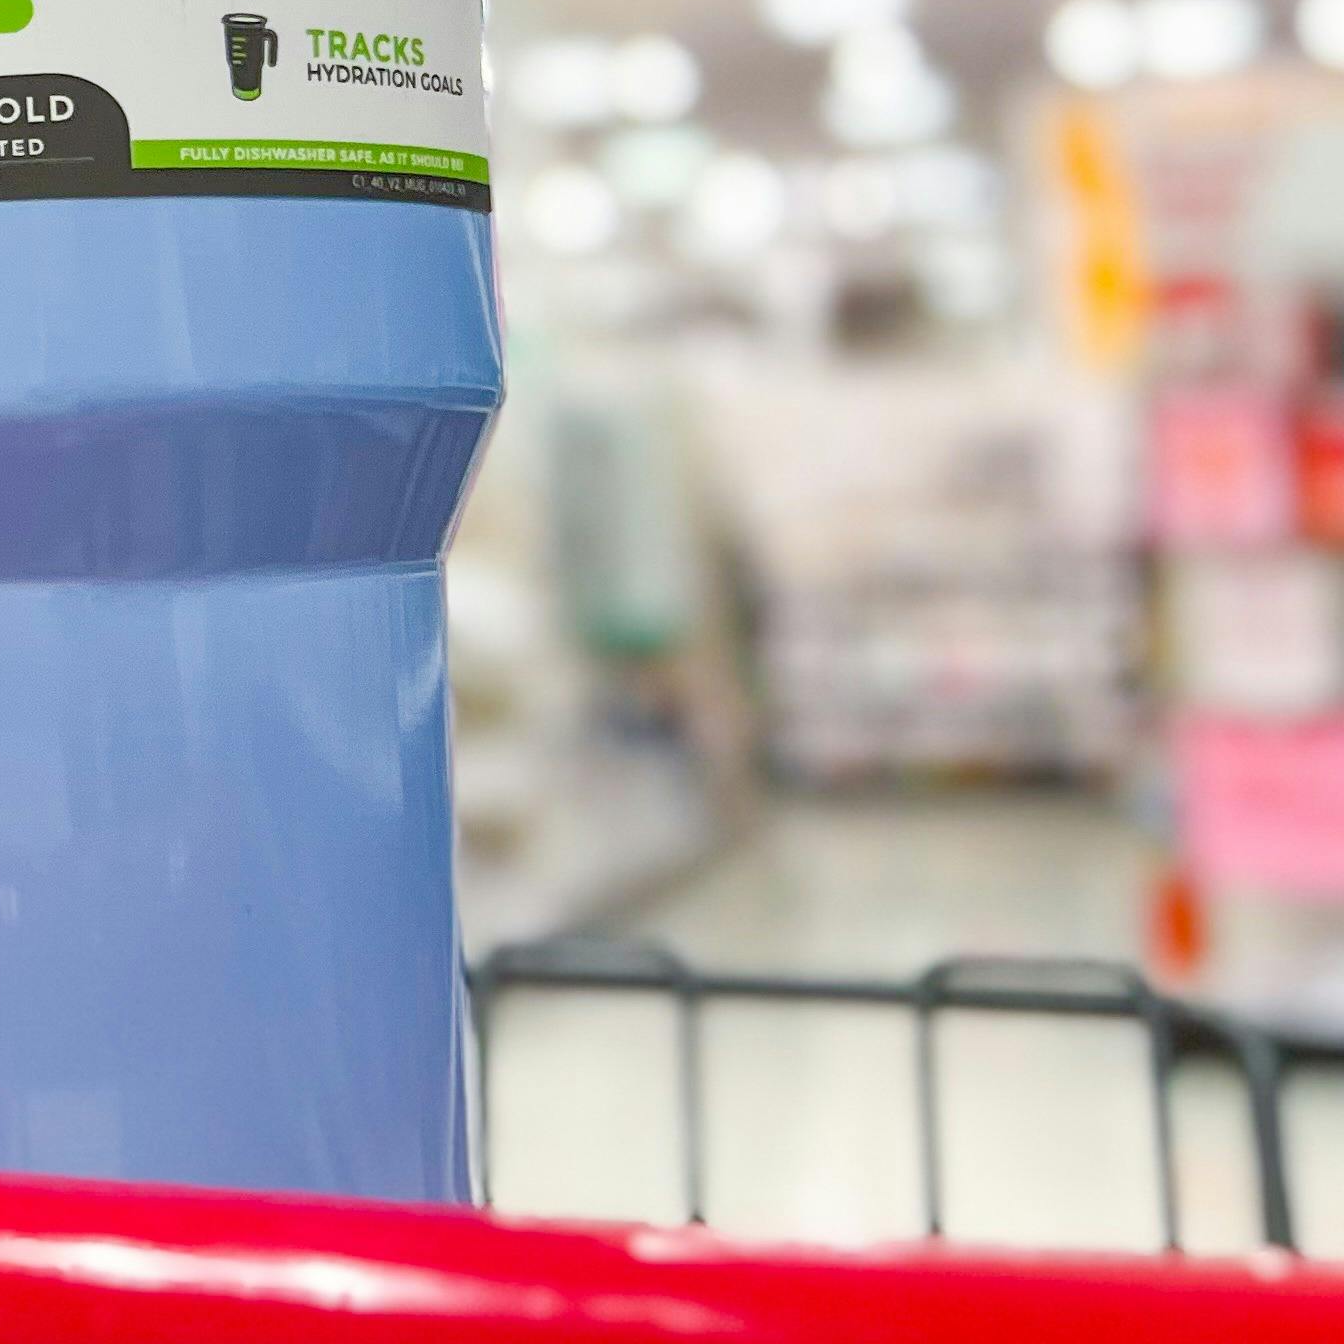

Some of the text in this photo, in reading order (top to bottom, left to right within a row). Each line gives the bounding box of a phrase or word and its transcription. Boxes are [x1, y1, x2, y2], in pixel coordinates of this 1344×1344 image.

[306, 29, 425, 66] TRACKS
[307, 63, 463, 96] HYDRATION GOALS
[180, 147, 229, 160] FULLY
[234, 147, 336, 161] DISHWASHER
[379, 151, 395, 165] AS
